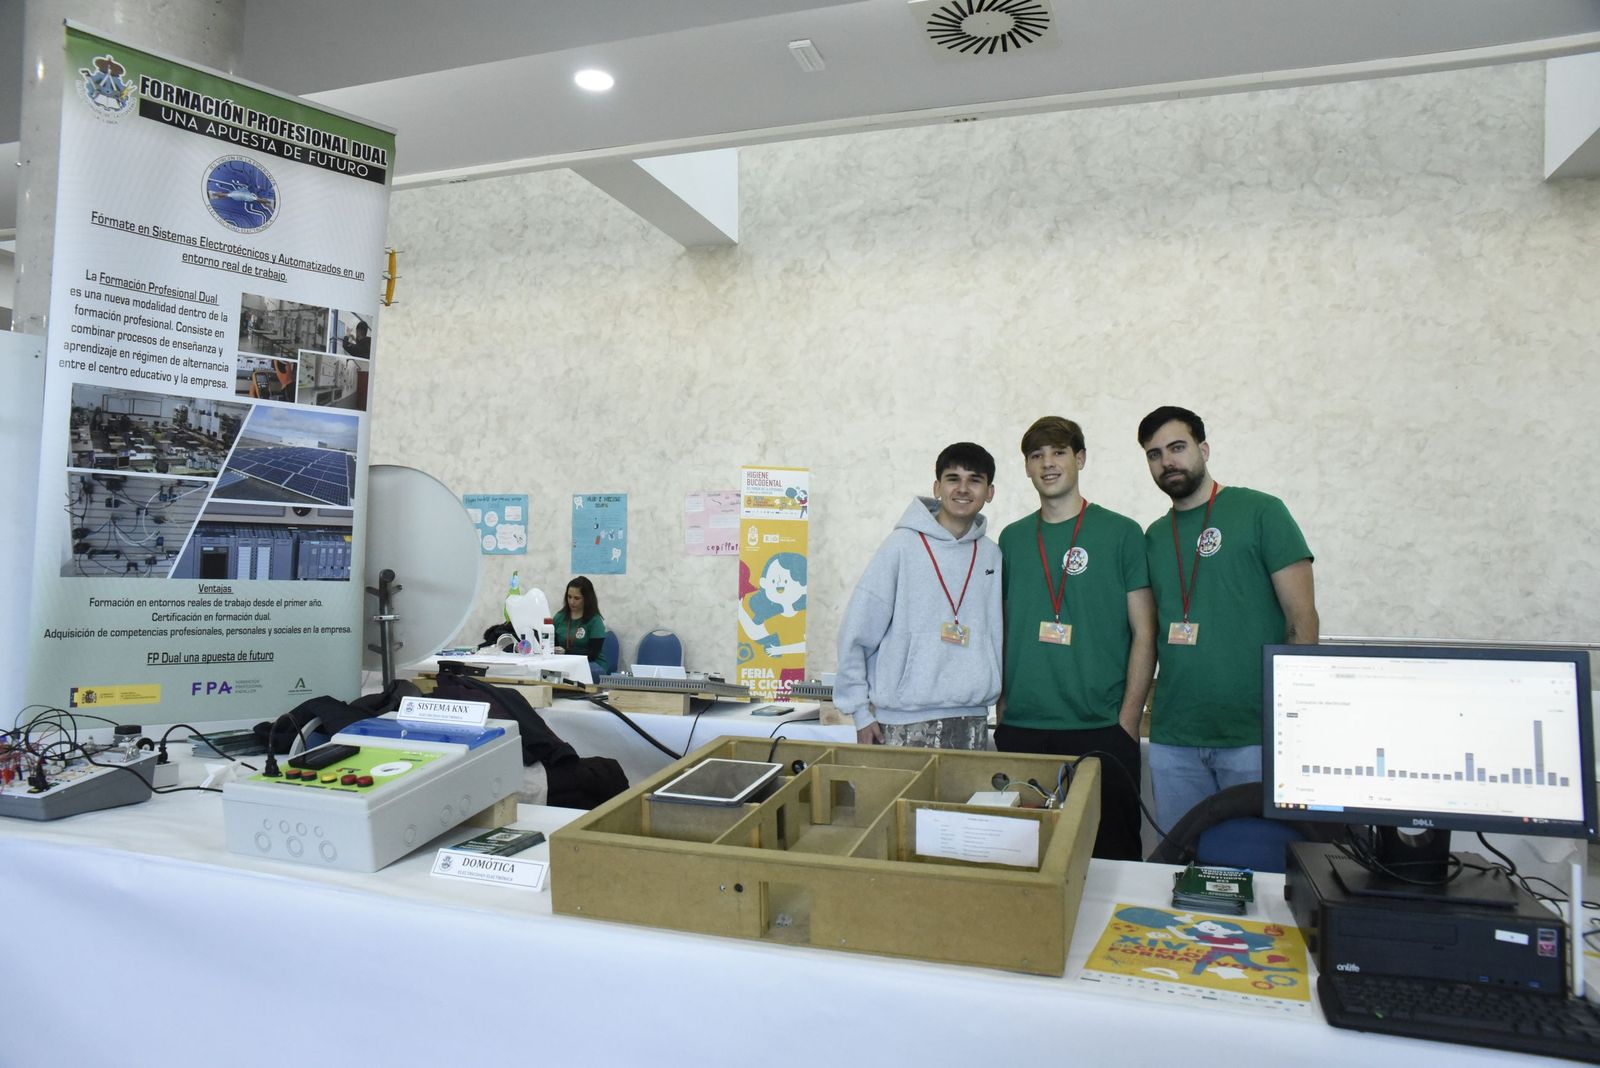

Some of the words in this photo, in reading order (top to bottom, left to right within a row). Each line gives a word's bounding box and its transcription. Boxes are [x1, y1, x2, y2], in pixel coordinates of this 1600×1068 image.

[140, 74, 244, 126] FORMACIÓN
[247, 109, 350, 155] PROFESIONAL
[351, 139, 388, 167] DUAL
[161, 106, 198, 130] UNA
[206, 122, 277, 153] APUESTA
[283, 144, 302, 160] DE
[308, 151, 369, 177] FUTURO
[91, 211, 135, 232] Fórmate
[138, 224, 150, 235] en
[152, 225, 197, 246] Sistemas
[199, 236, 270, 261] Electrotécnicos
[271, 253, 277, 265] y
[278, 253, 341, 276] Automatizados
[343, 268, 354, 278] en
[355, 271, 365, 280] un
[182, 252, 219, 268] entorno
[221, 259, 240, 271] real
[242, 263, 253, 274] de
[255, 266, 288, 282] trabajo.
[85, 269, 97, 281] La
[99, 272, 146, 290] Formación
[148, 282, 197, 300] Profesional
[198, 291, 218, 304] Dual
[70, 287, 82, 297] es
[84, 290, 102, 301] una
[104, 293, 130, 306] nueva
[132, 298, 176, 314] modalidad
[178, 305, 207, 319] dentro
[208, 310, 219, 321] de
[221, 312, 228, 322] la
[74, 304, 122, 322] formación
[123, 314, 174, 330] profesional.
[176, 321, 213, 336] Consiste
[214, 329, 225, 339] en
[71, 323, 116, 338] combinar
[117, 331, 157, 346] procesos
[159, 336, 170, 347] de
[172, 340, 216, 354] enseñanza
[218, 347, 224, 357] y
[63, 341, 117, 358] aprendizaje
[119, 349, 130, 359] en
[132, 350, 168, 364] régimen
[169, 355, 181, 366] de
[182, 357, 229, 373] alternancia
[59, 359, 86, 370] entre
[88, 361, 96, 371] el
[98, 364, 128, 376] centro
[130, 368, 171, 382] educativo
[173, 375, 179, 385] y
[180, 374, 188, 384] la
[190, 377, 229, 389] empresa.
[746, 471, 769, 479] HIGIENE
[746, 478, 783, 487] BUCODENTAL
[198, 584, 232, 594] Ventajas
[89, 597, 135, 607] Formación
[136, 599, 147, 607] en
[149, 599, 186, 607] entornos
[187, 598, 212, 607] reales
[213, 598, 223, 607] de
[224, 598, 251, 609] trabajo
[252, 598, 275, 607] desde
[276, 597, 283, 607] el
[283, 598, 308, 609] primer
[308, 598, 323, 607] año.
[151, 612, 202, 622] Certificación
[203, 613, 213, 621] en
[215, 612, 253, 621] formación
[254, 612, 271, 621] dual.
[44, 628, 95, 640] Adquisición
[97, 628, 108, 638] de
[110, 627, 168, 639] competencias
[170, 626, 224, 638] profesionales,
[225, 626, 266, 637] personales
[268, 626, 272, 636] y
[273, 625, 302, 634] sociales
[303, 626, 312, 634] en
[313, 625, 319, 634] la
[320, 626, 352, 635] empresa.
[147, 652, 160, 664] FP
[161, 652, 182, 664] Dual
[183, 653, 200, 663] una
[201, 652, 235, 664] apuesta
[237, 651, 247, 661] de
[249, 650, 274, 660] futuro
[741, 667, 774, 679] FERIA
[191, 681, 233, 696] FPA
[741, 679, 755, 689] DE
[417, 702, 451, 713] SISTEMA
[452, 704, 470, 714] KNX
[1412, 818, 1434, 827] DELL
[462, 857, 515, 873] DOMÓTICA
[1116, 934, 1190, 950] XIV
